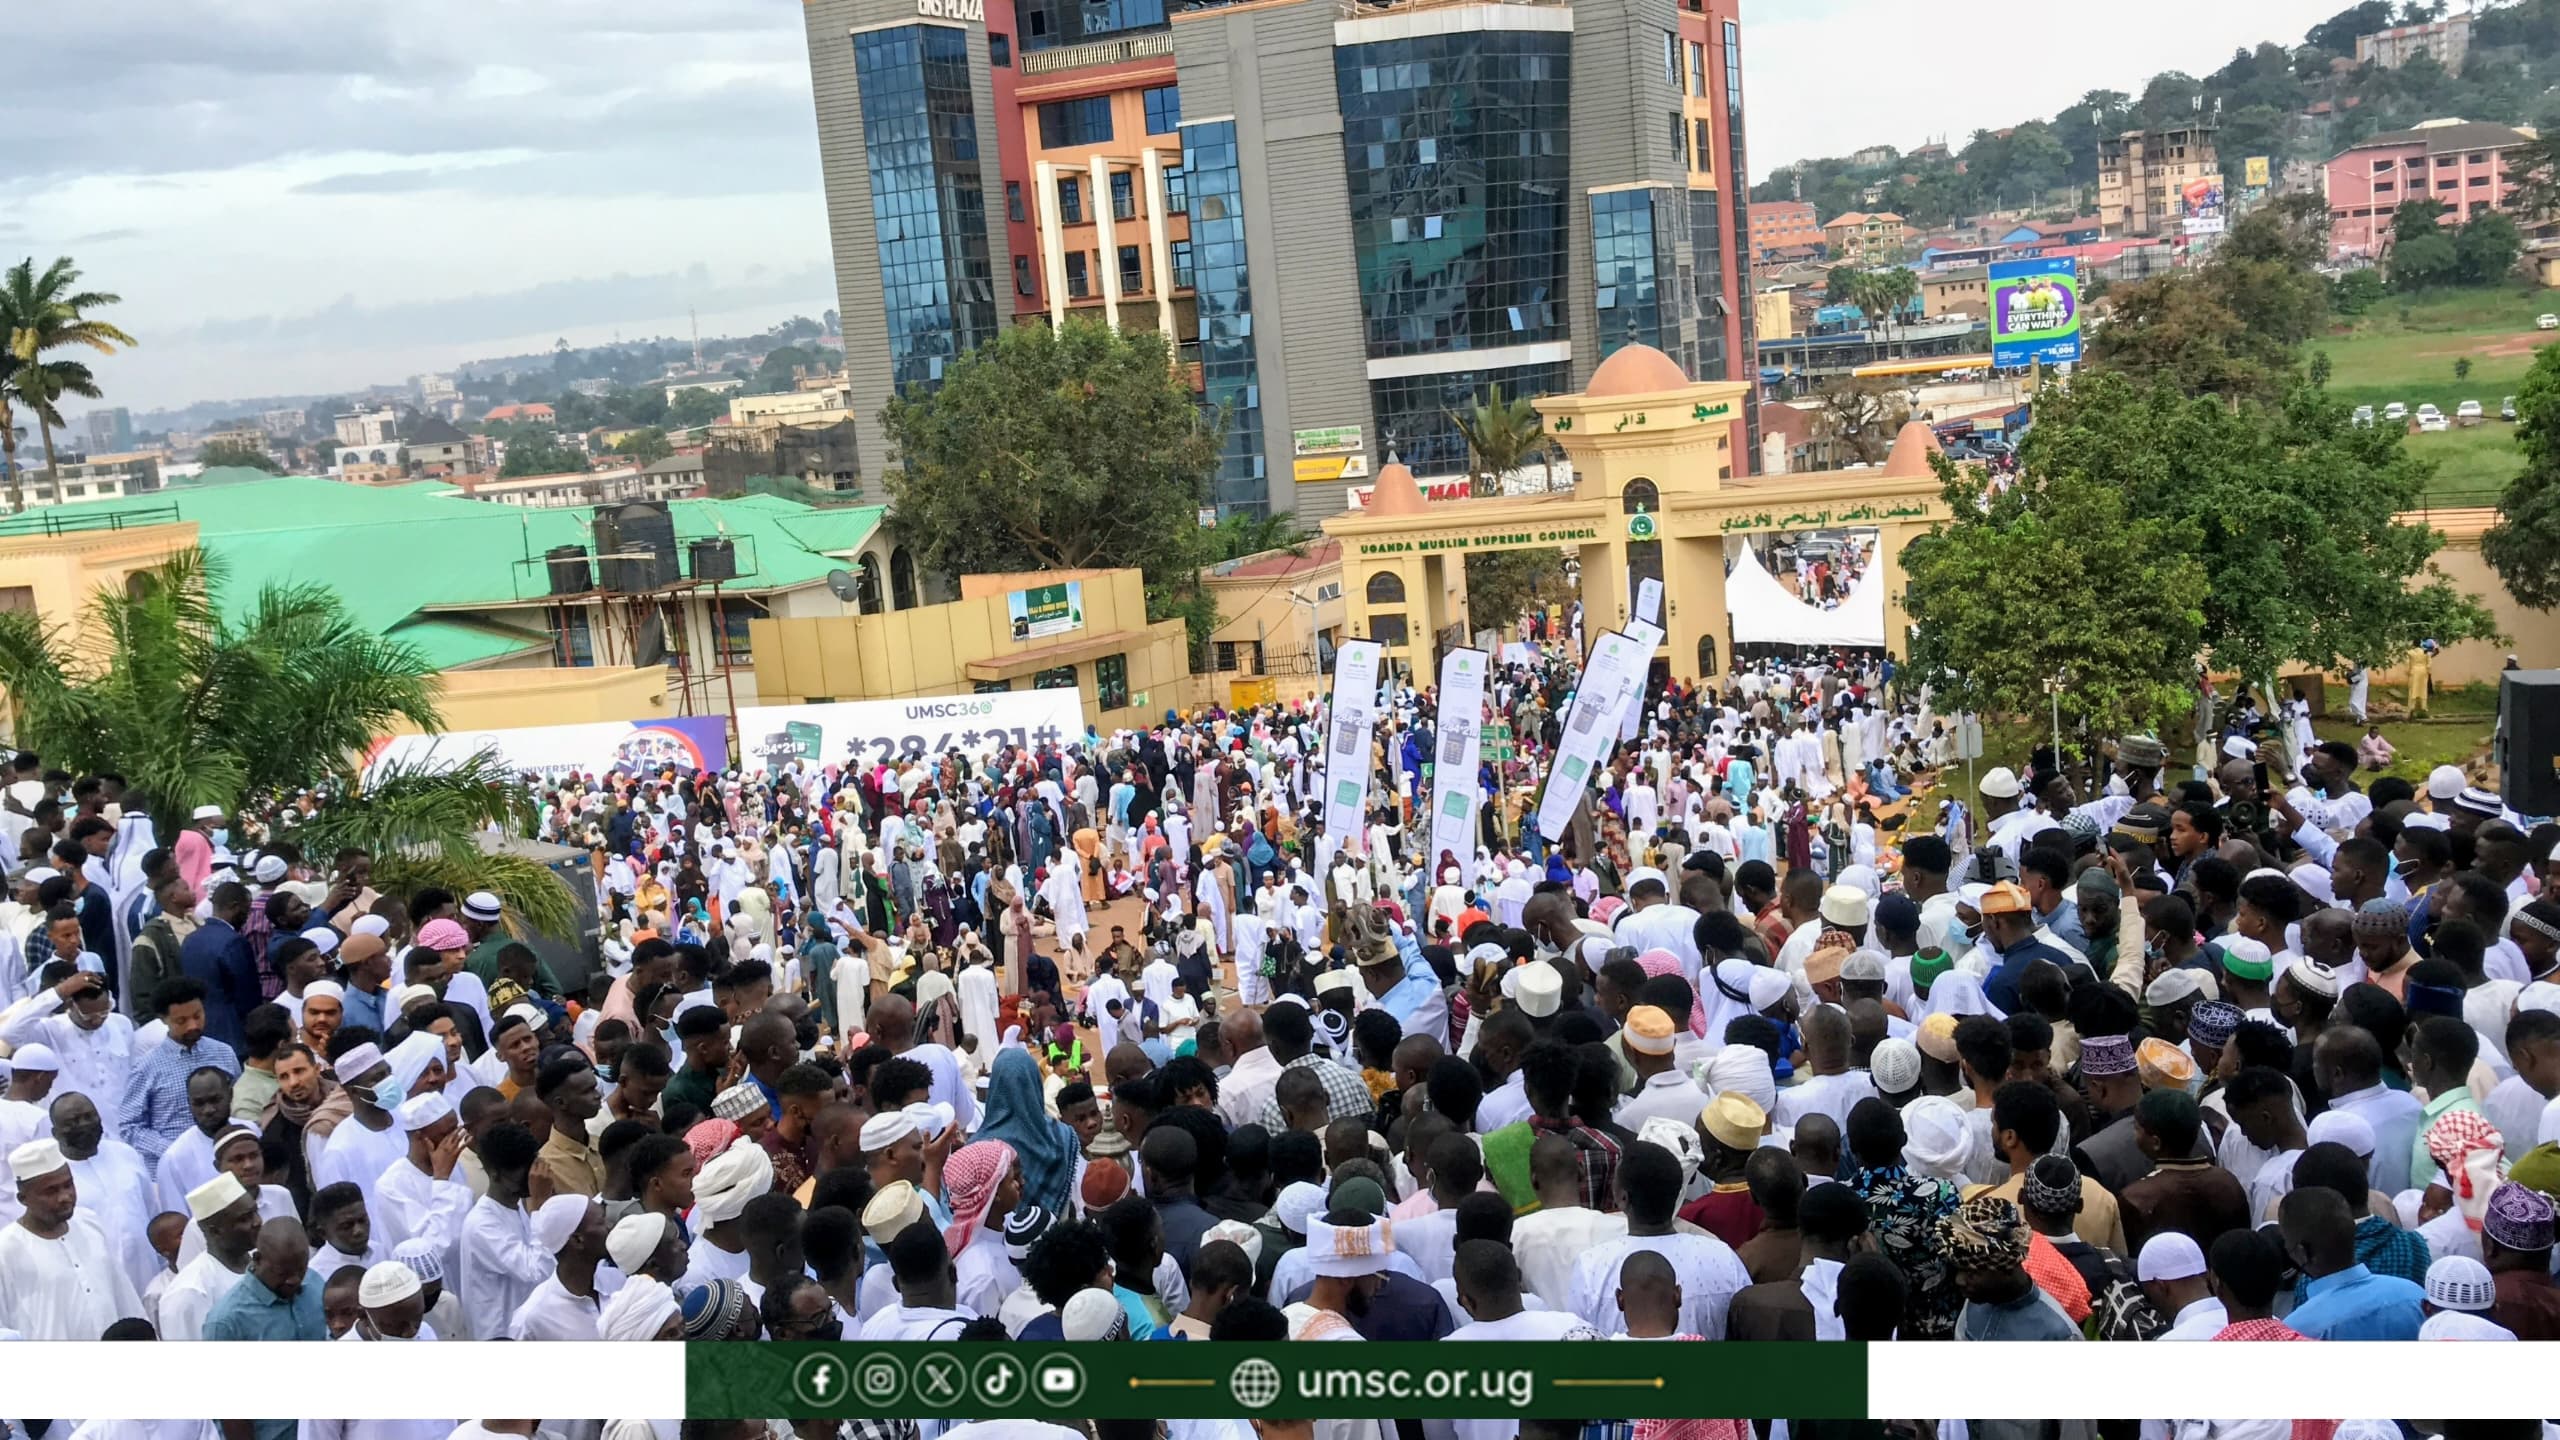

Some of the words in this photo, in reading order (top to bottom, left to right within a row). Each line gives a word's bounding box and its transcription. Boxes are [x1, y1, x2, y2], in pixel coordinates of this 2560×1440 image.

[945, 0, 984, 21] PLAZA
[2008, 311, 2068, 322] EVERYTHING
[2008, 322, 2029, 331] CAN
[2031, 320, 2054, 329] WAIT
[1692, 403, 1729, 422] مسجد
[1879, 502, 1928, 520] المجلس
[1360, 541, 1413, 554] UGANDA
[1419, 537, 1468, 550] MUSLIM
[1474, 533, 1532, 546] SUPREME
[1539, 528, 1597, 541] COUNCIL
[906, 701, 992, 719] UMSC360
[517, 763, 585, 774] UNIVERSITY
